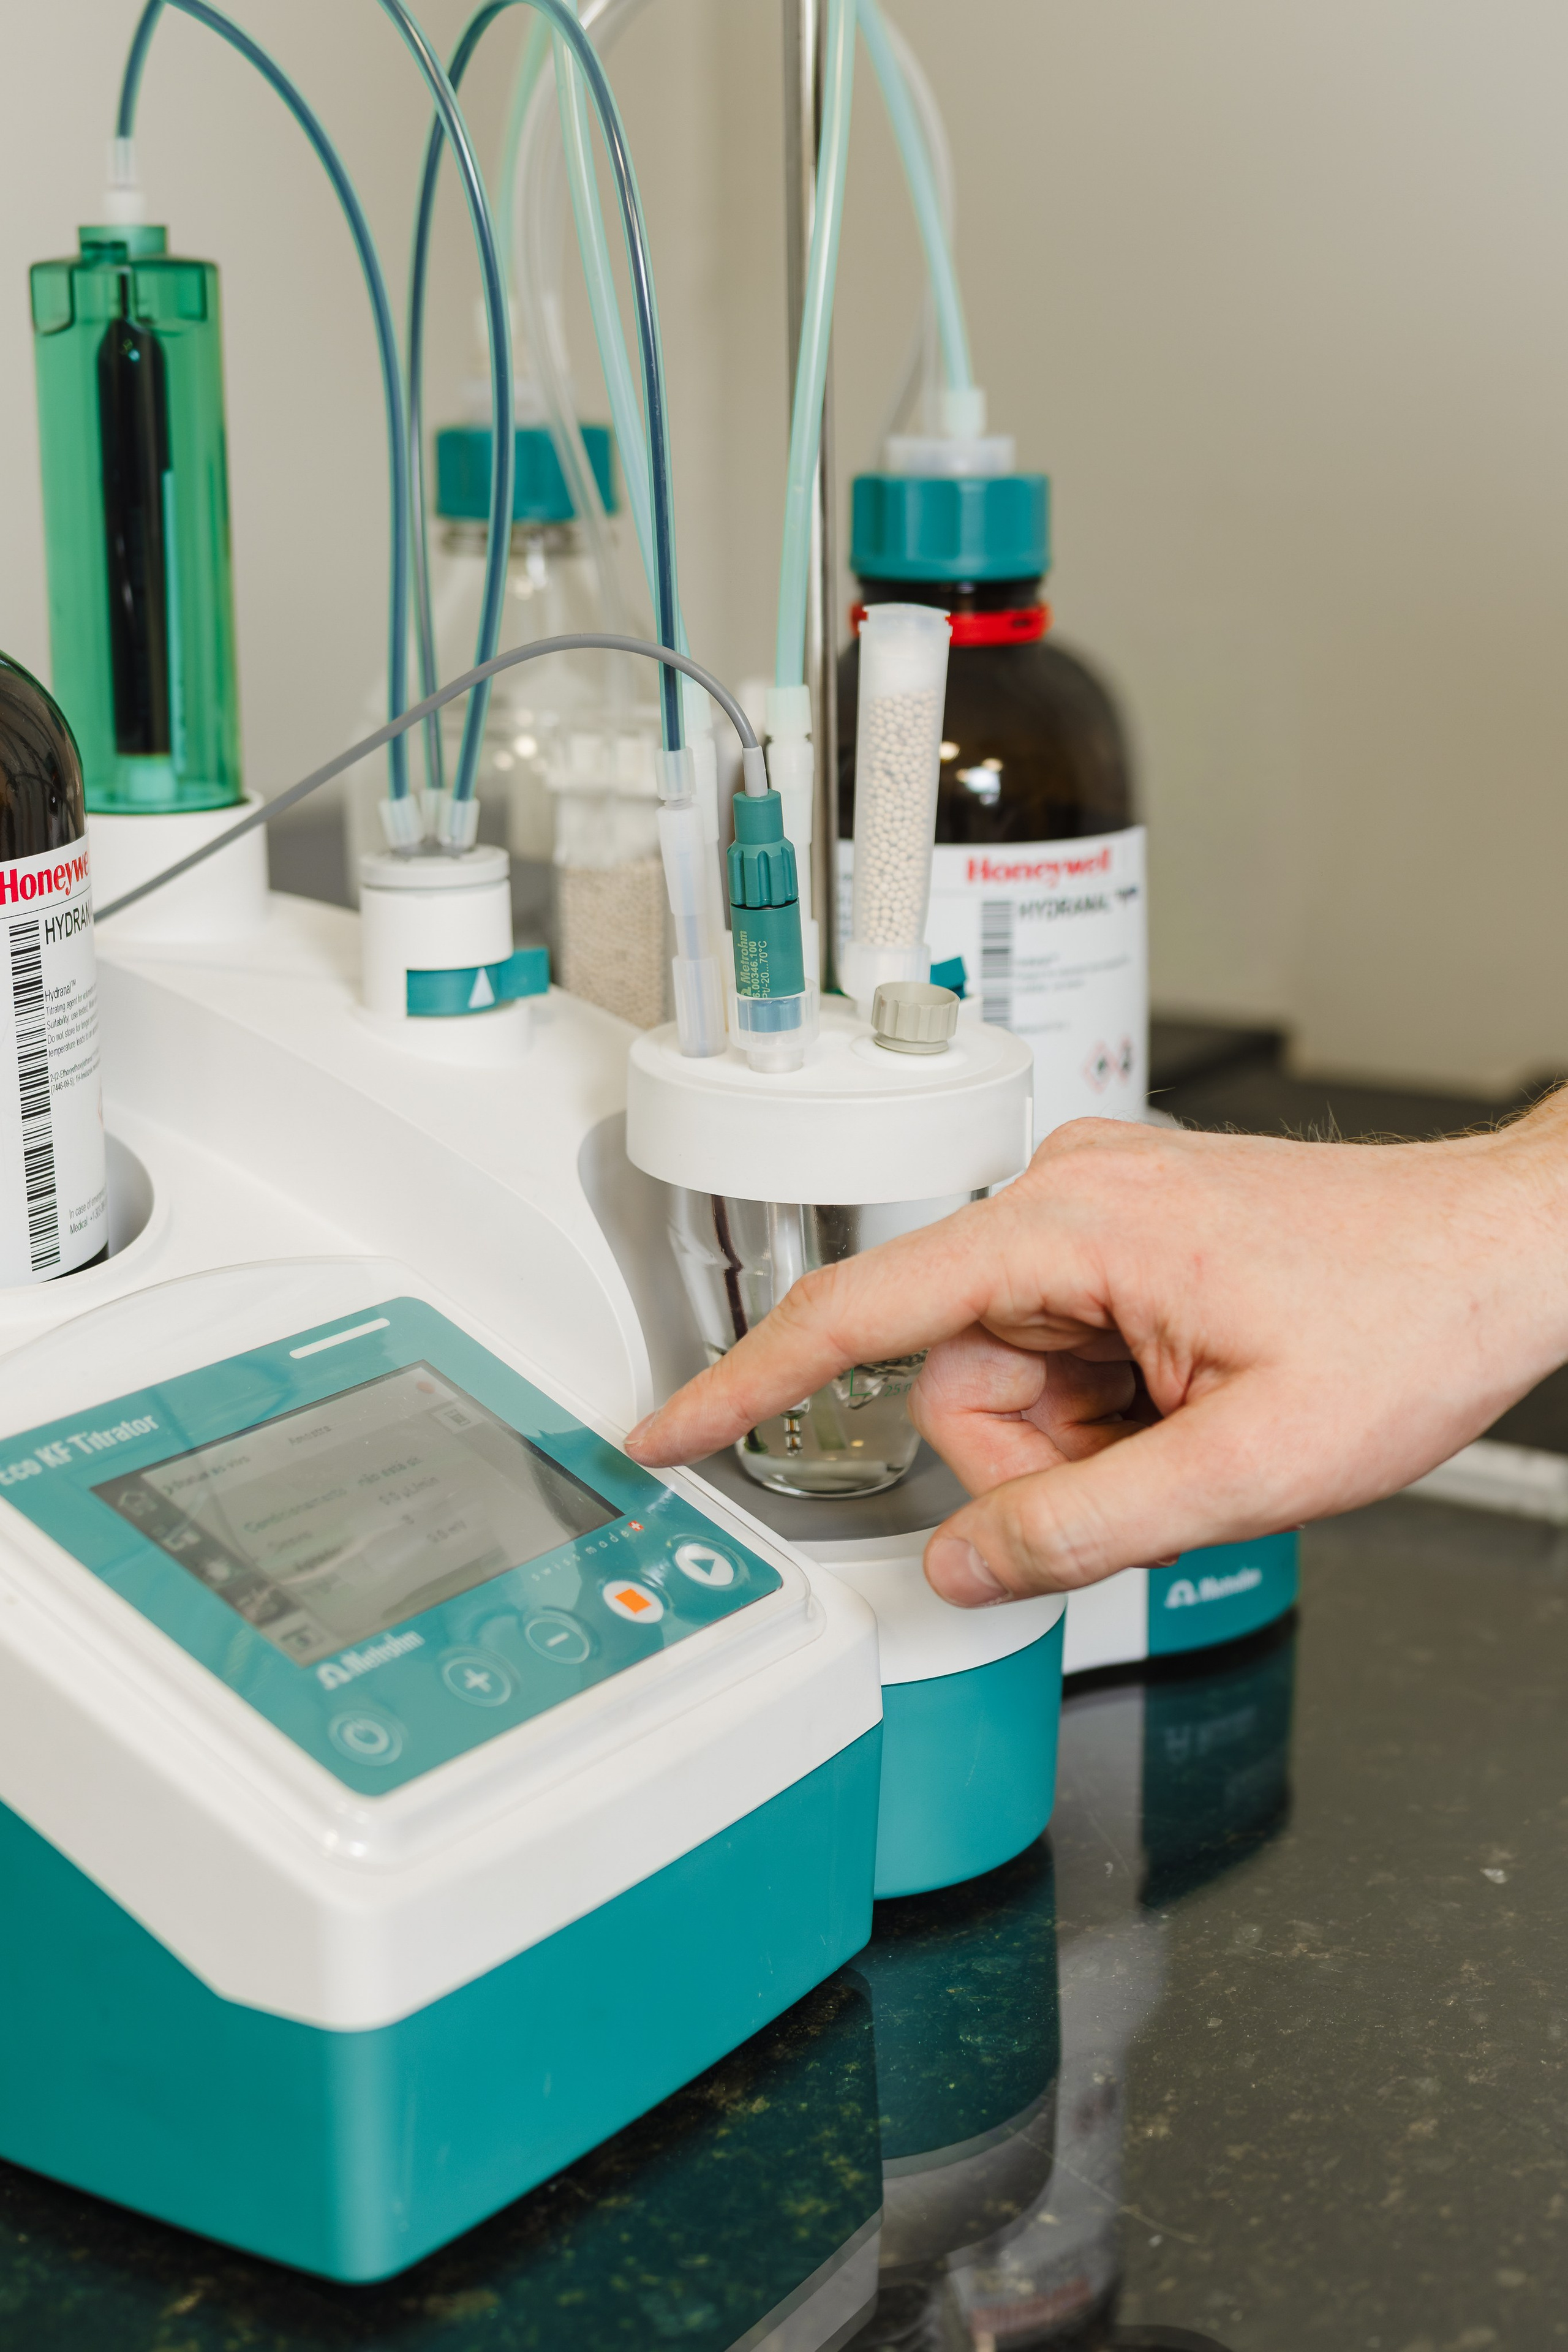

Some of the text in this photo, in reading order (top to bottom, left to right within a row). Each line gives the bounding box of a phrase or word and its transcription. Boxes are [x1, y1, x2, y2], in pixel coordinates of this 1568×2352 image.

[737, 930, 751, 984] Metrohm
[748, 941, 761, 998] 6.00346.100
[46, 1003, 66, 1017] Titrating
[47, 1034, 56, 1044] Do
[56, 1030, 64, 1042] not
[64, 1026, 75, 1038] store
[48, 1040, 76, 1058] temperature
[69, 1208, 74, 1219] In
[75, 1203, 86, 1216] case
[34, 1441, 74, 1469] KF
[66, 1414, 159, 1455] Titrator
[585, 1529, 630, 1555] made
